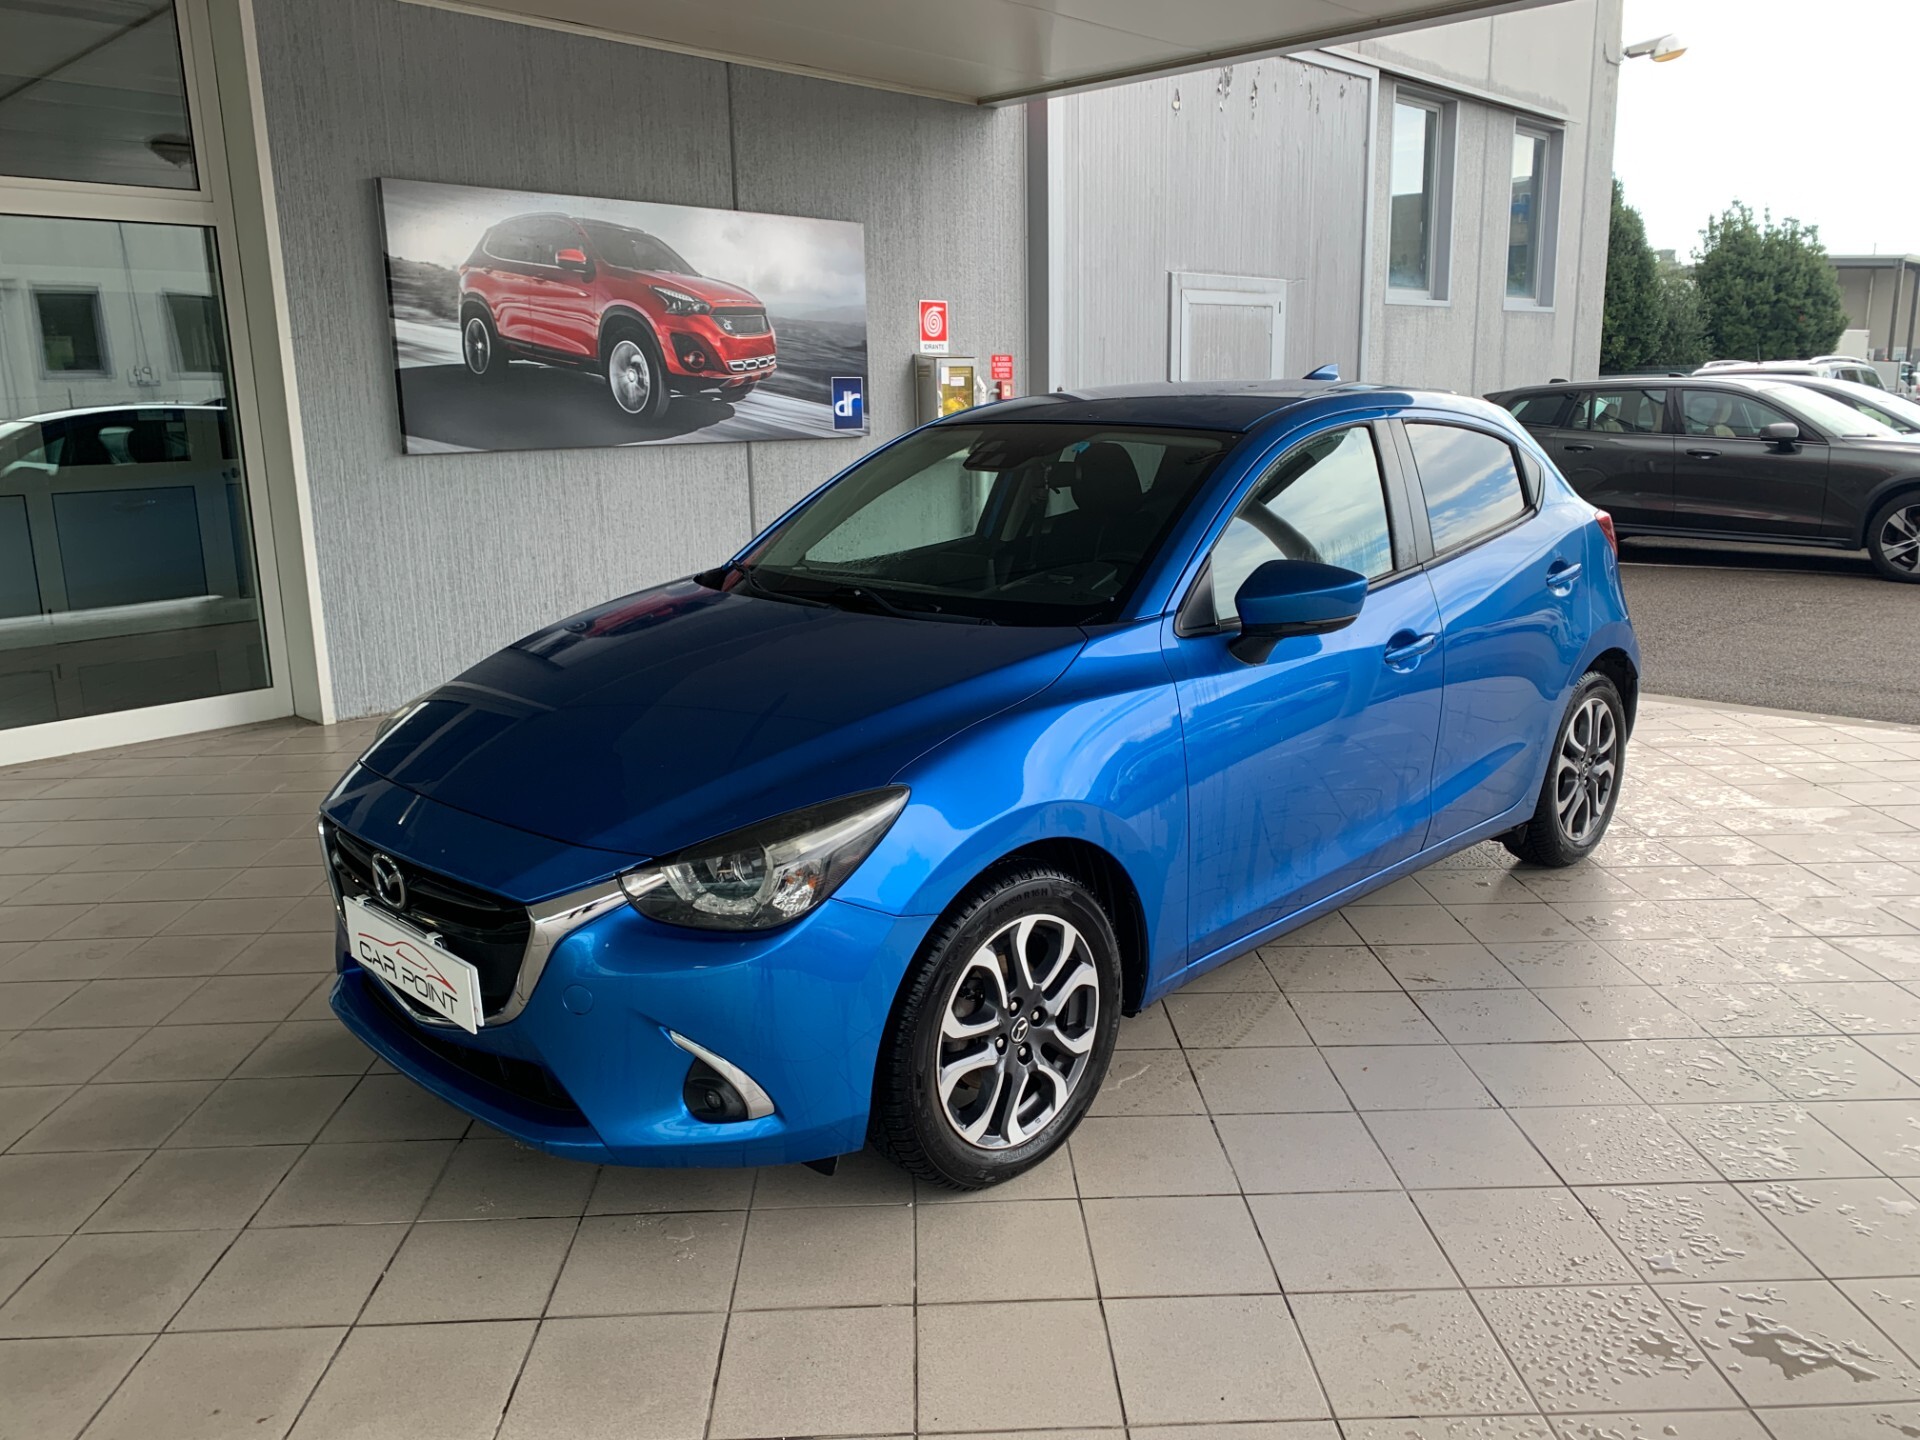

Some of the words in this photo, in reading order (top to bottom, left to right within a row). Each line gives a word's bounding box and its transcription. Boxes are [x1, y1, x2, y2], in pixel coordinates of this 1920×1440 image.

[834, 390, 861, 417] dr
[359, 940, 397, 980] CAR
[401, 966, 458, 1014] POINT
